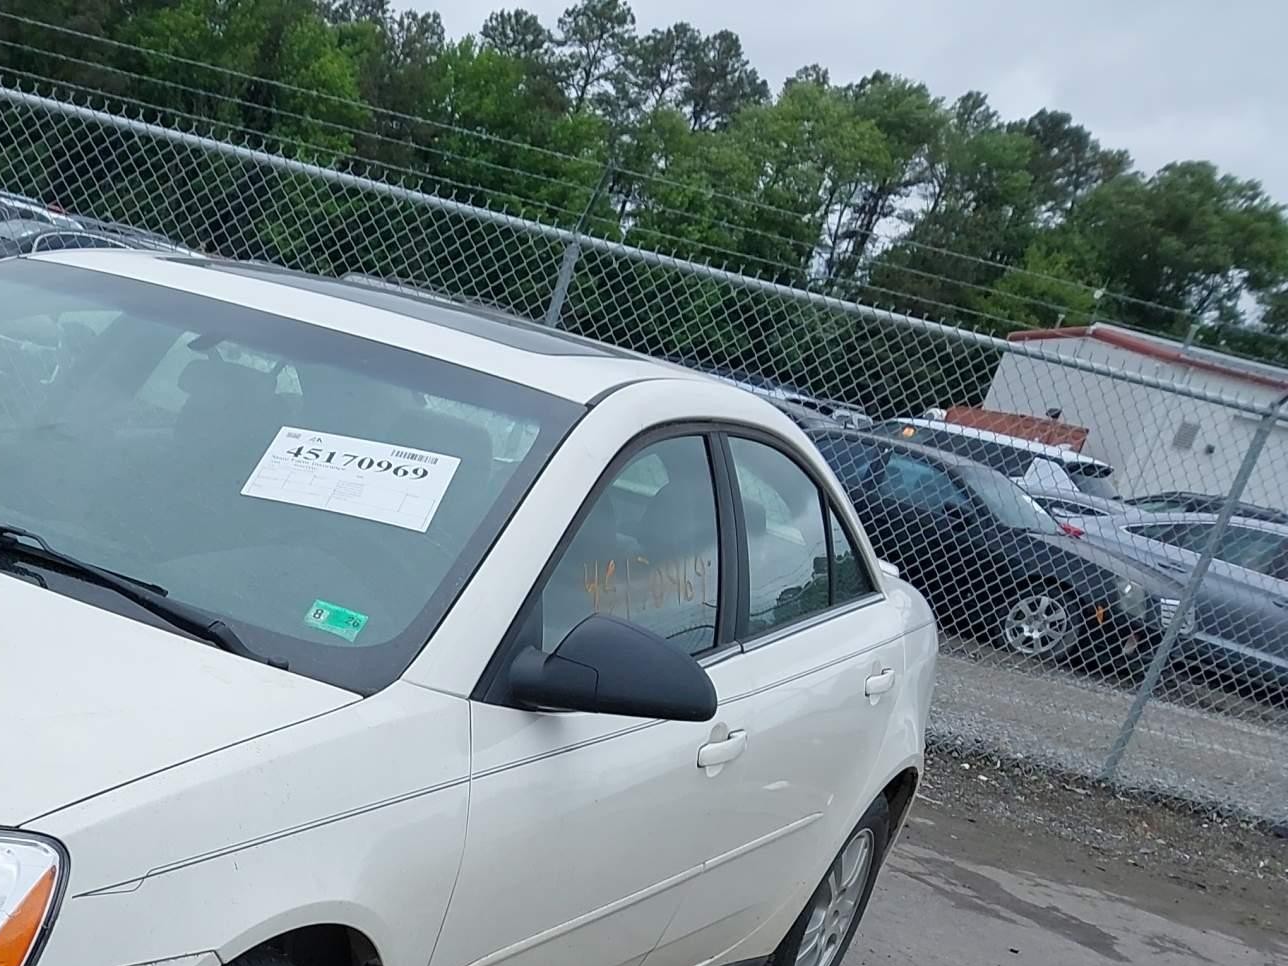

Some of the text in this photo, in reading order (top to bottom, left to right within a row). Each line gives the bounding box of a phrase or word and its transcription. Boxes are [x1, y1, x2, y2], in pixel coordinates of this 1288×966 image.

[286, 445, 429, 480] 45170969
[313, 608, 362, 627] 8 26
